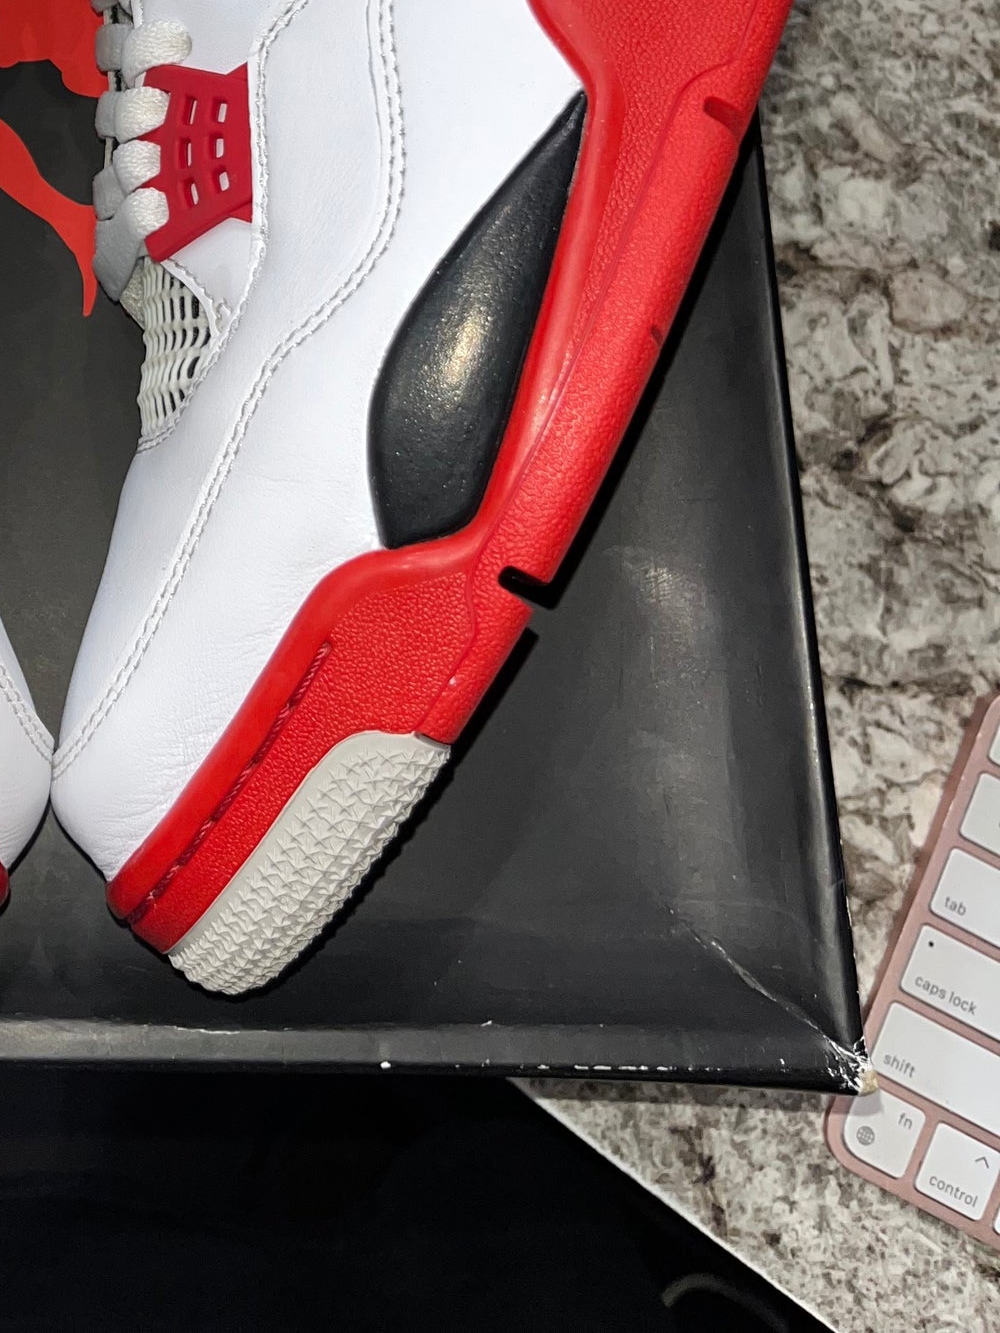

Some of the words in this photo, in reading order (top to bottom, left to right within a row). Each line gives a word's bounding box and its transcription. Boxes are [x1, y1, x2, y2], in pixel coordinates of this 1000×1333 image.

[944, 895, 967, 916] tab
[914, 975, 946, 1000] caps
[948, 991, 977, 1016] lock
[883, 1052, 916, 1078] shift
[898, 1112, 913, 1130] fn
[928, 1174, 979, 1207] control
